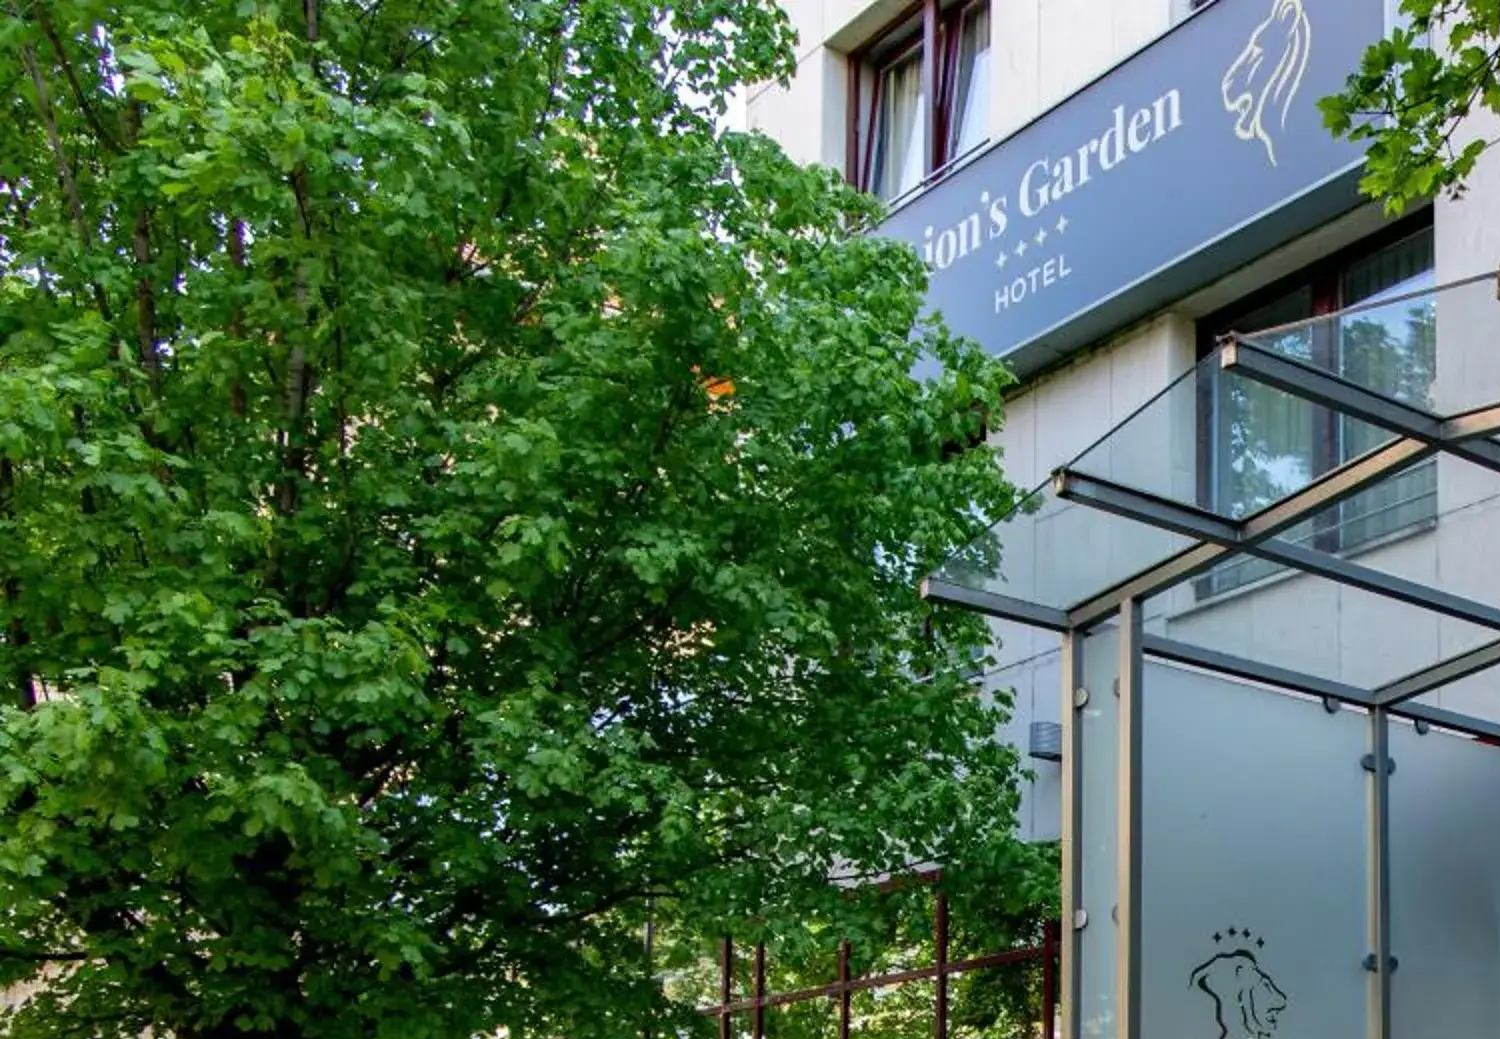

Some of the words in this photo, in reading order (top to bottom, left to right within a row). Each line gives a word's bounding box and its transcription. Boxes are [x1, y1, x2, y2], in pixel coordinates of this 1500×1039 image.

[922, 189, 1008, 269] ion's
[1019, 88, 1184, 217] Garden
[994, 254, 1072, 314] HOTEL
